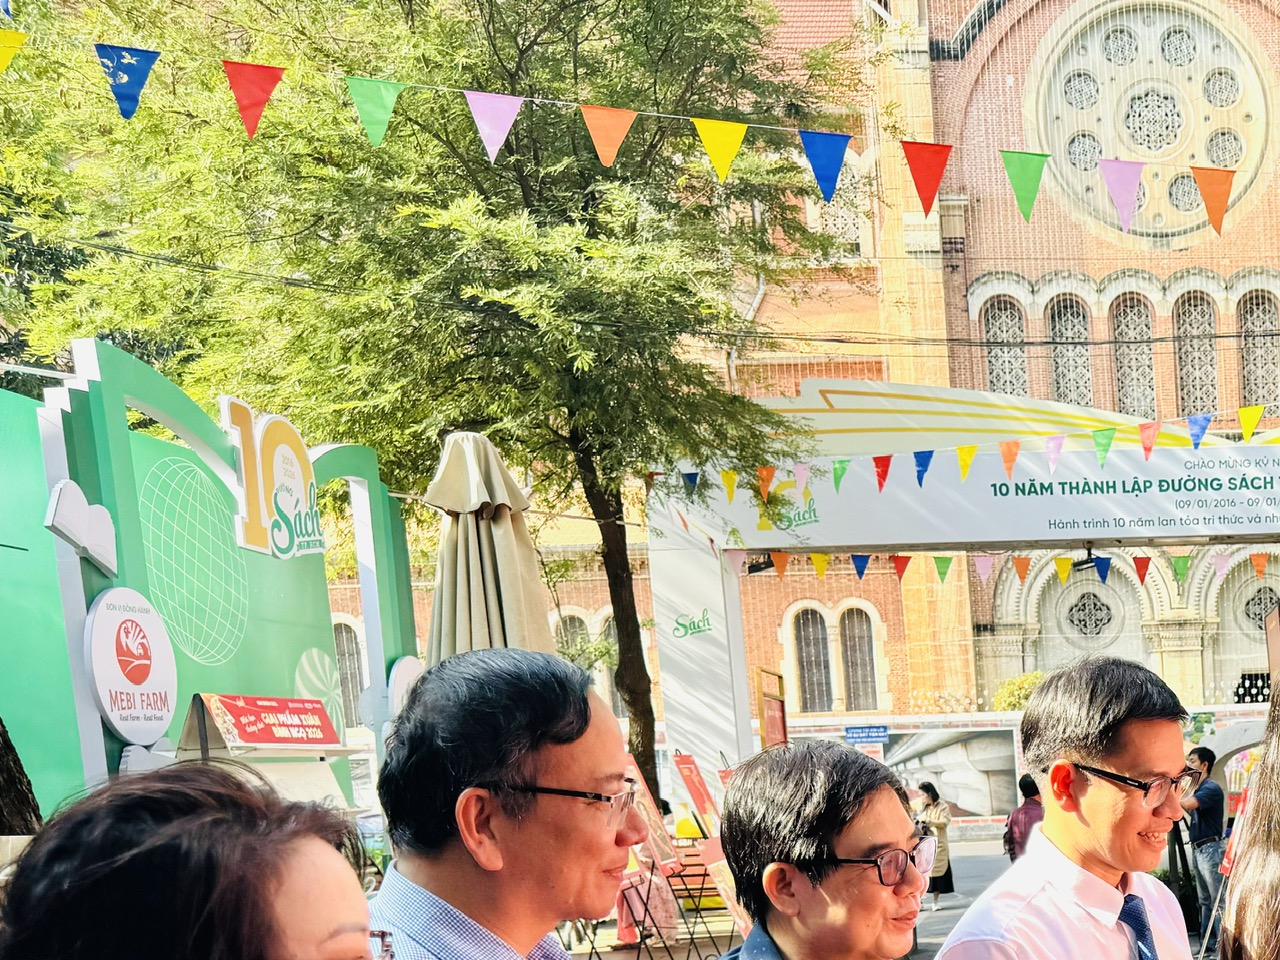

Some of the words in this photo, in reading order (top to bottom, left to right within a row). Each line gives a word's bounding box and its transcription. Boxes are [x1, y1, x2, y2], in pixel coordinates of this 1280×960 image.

[1184, 457, 1216, 470] CHÀO
[1219, 456, 1252, 469] MỪNG
[1254, 455, 1269, 468] KỶ
[990, 483, 1010, 497] 10
[1015, 478, 1054, 496] NĂM
[1058, 476, 1117, 495] THÀNH
[1122, 476, 1153, 498] LẬP
[1158, 473, 1223, 493] ĐƯỜNG
[1228, 472, 1274, 491] SÁCH
[1175, 498, 1236, 510] (09/01/2016
[271, 481, 324, 555] Sách
[1048, 519, 1079, 530] Hành
[1083, 517, 1110, 529] trình
[1113, 518, 1125, 528] 10
[1129, 516, 1155, 528] năm
[1158, 516, 1176, 527] lan
[1218, 513, 1244, 525] thức
[1247, 513, 1261, 524] và
[672, 607, 713, 638] Sách
[109, 689, 137, 712] MEBI
[140, 691, 170, 713] FARM
